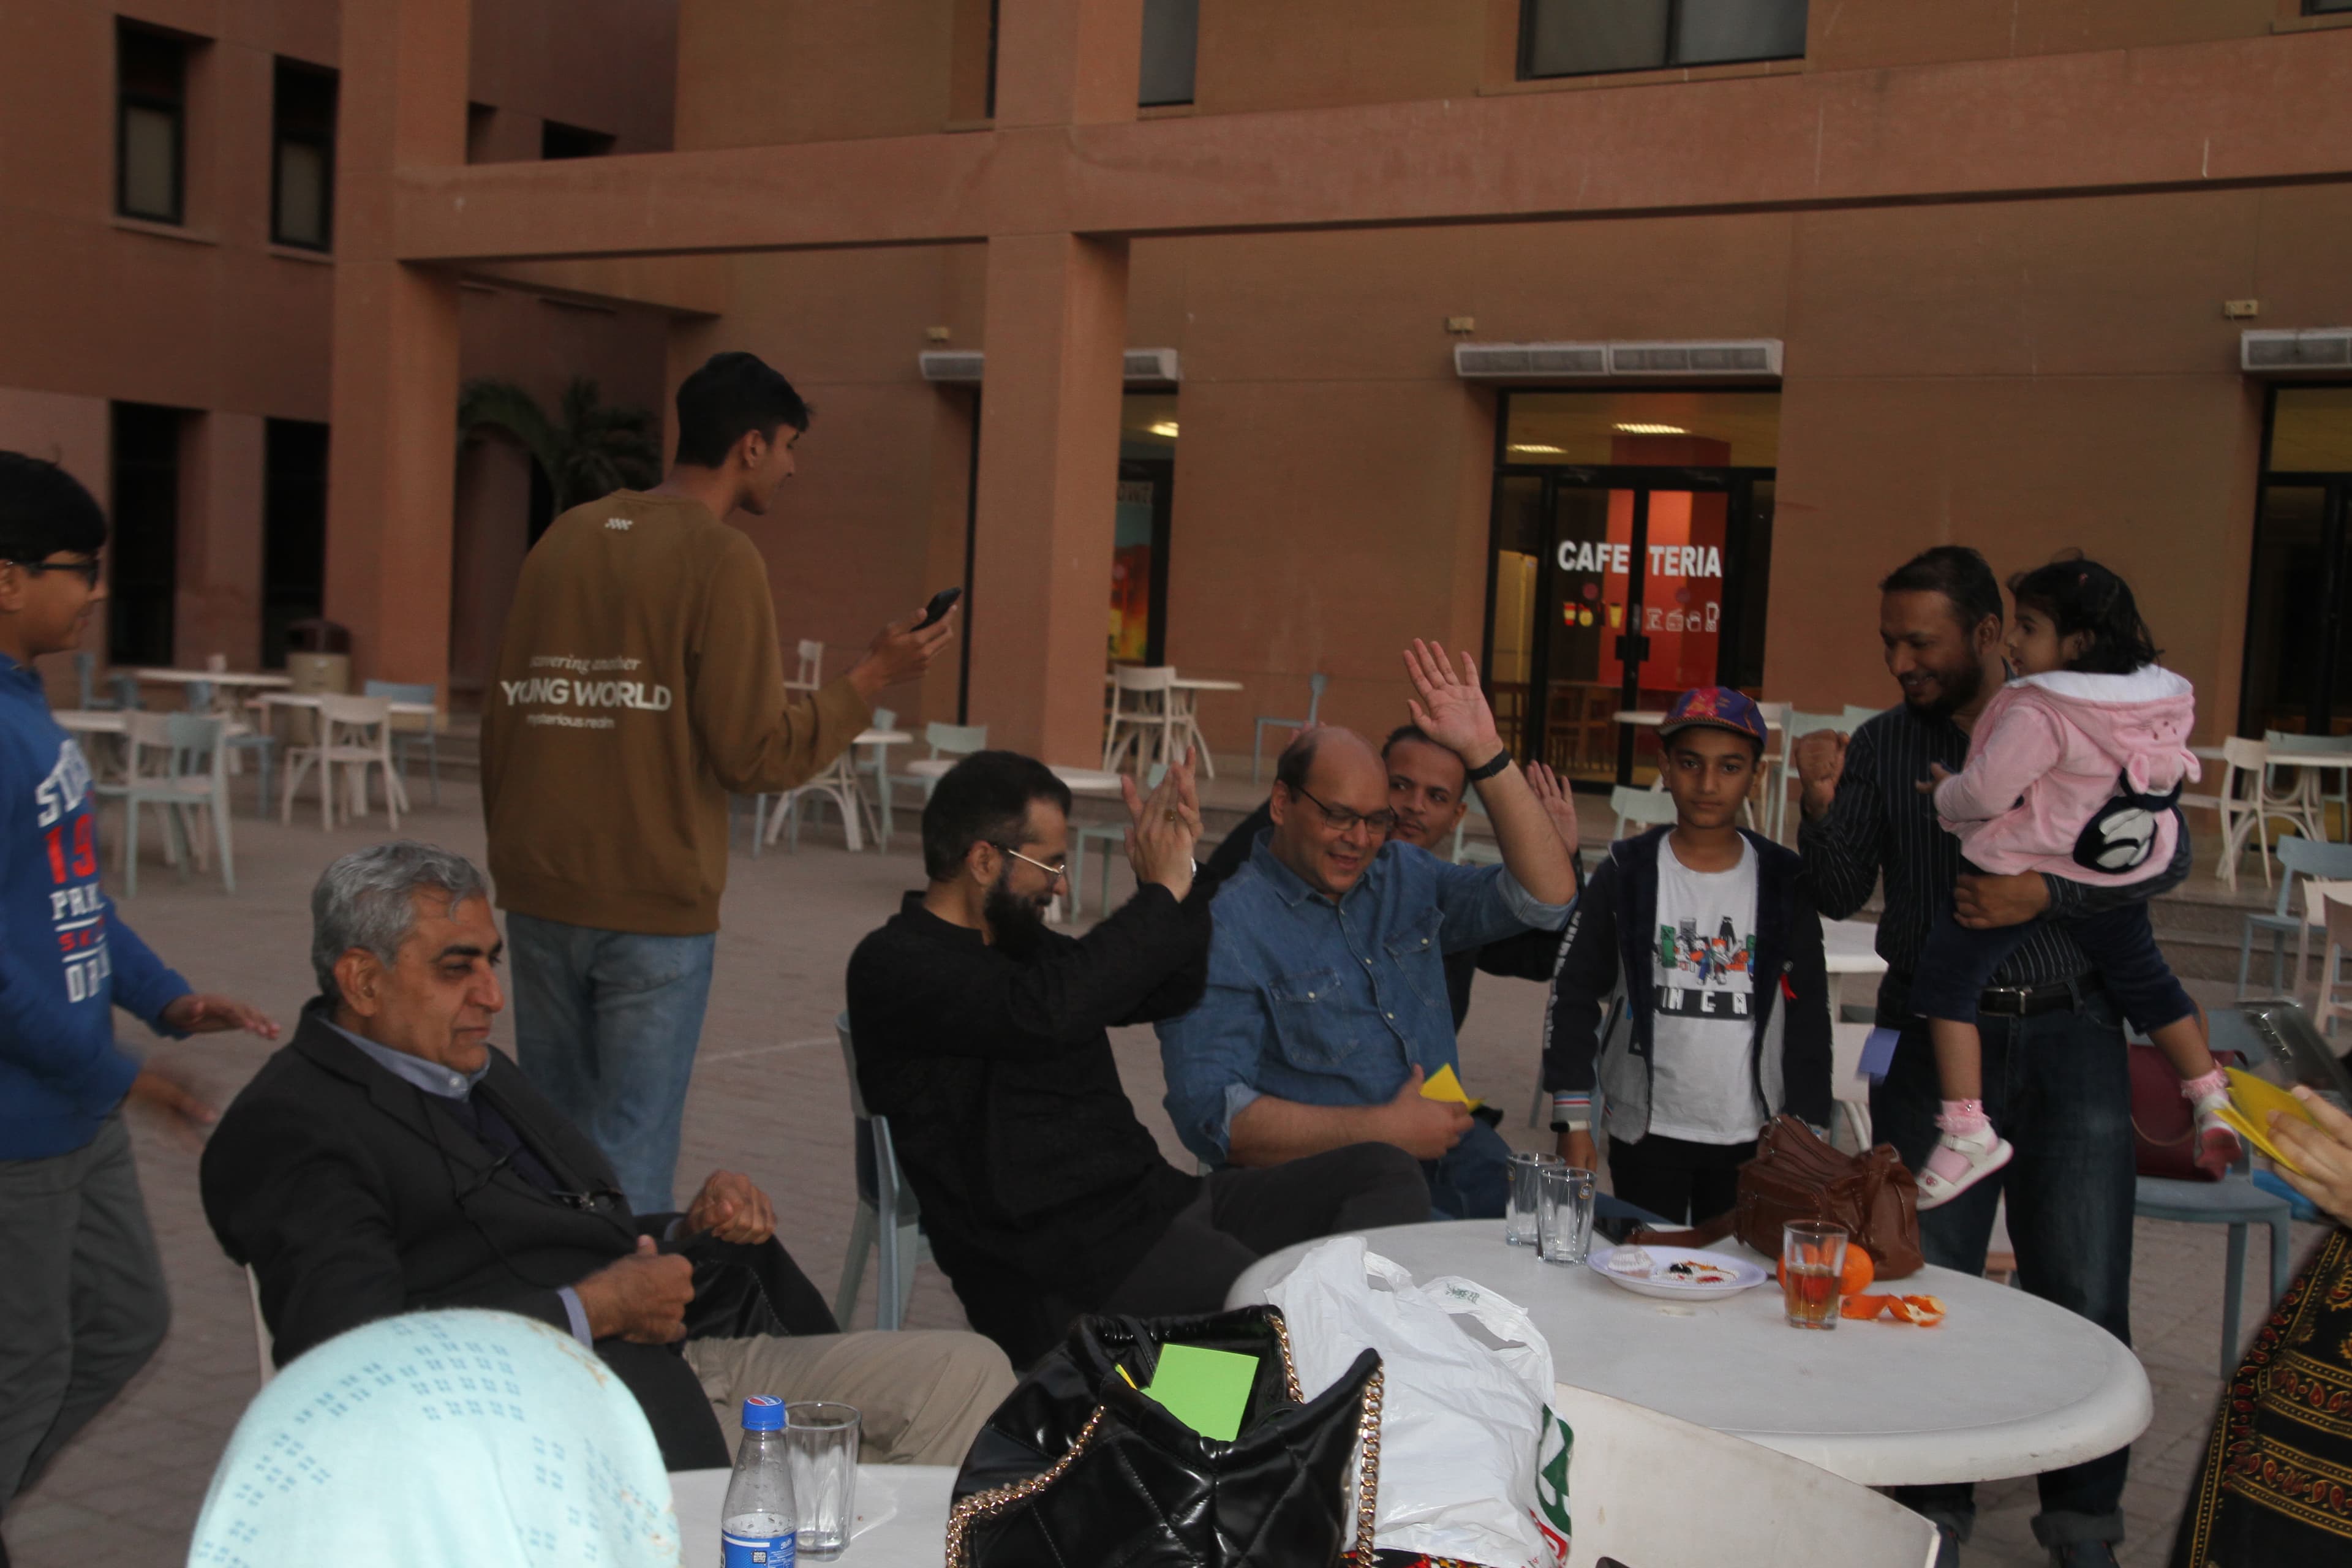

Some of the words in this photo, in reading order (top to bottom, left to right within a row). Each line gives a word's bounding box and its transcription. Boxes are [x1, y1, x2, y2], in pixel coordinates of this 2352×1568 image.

[1556, 539, 1631, 575] CAFE
[1648, 544, 1723, 578] TERIA
[573, 679, 673, 711] WORLD
